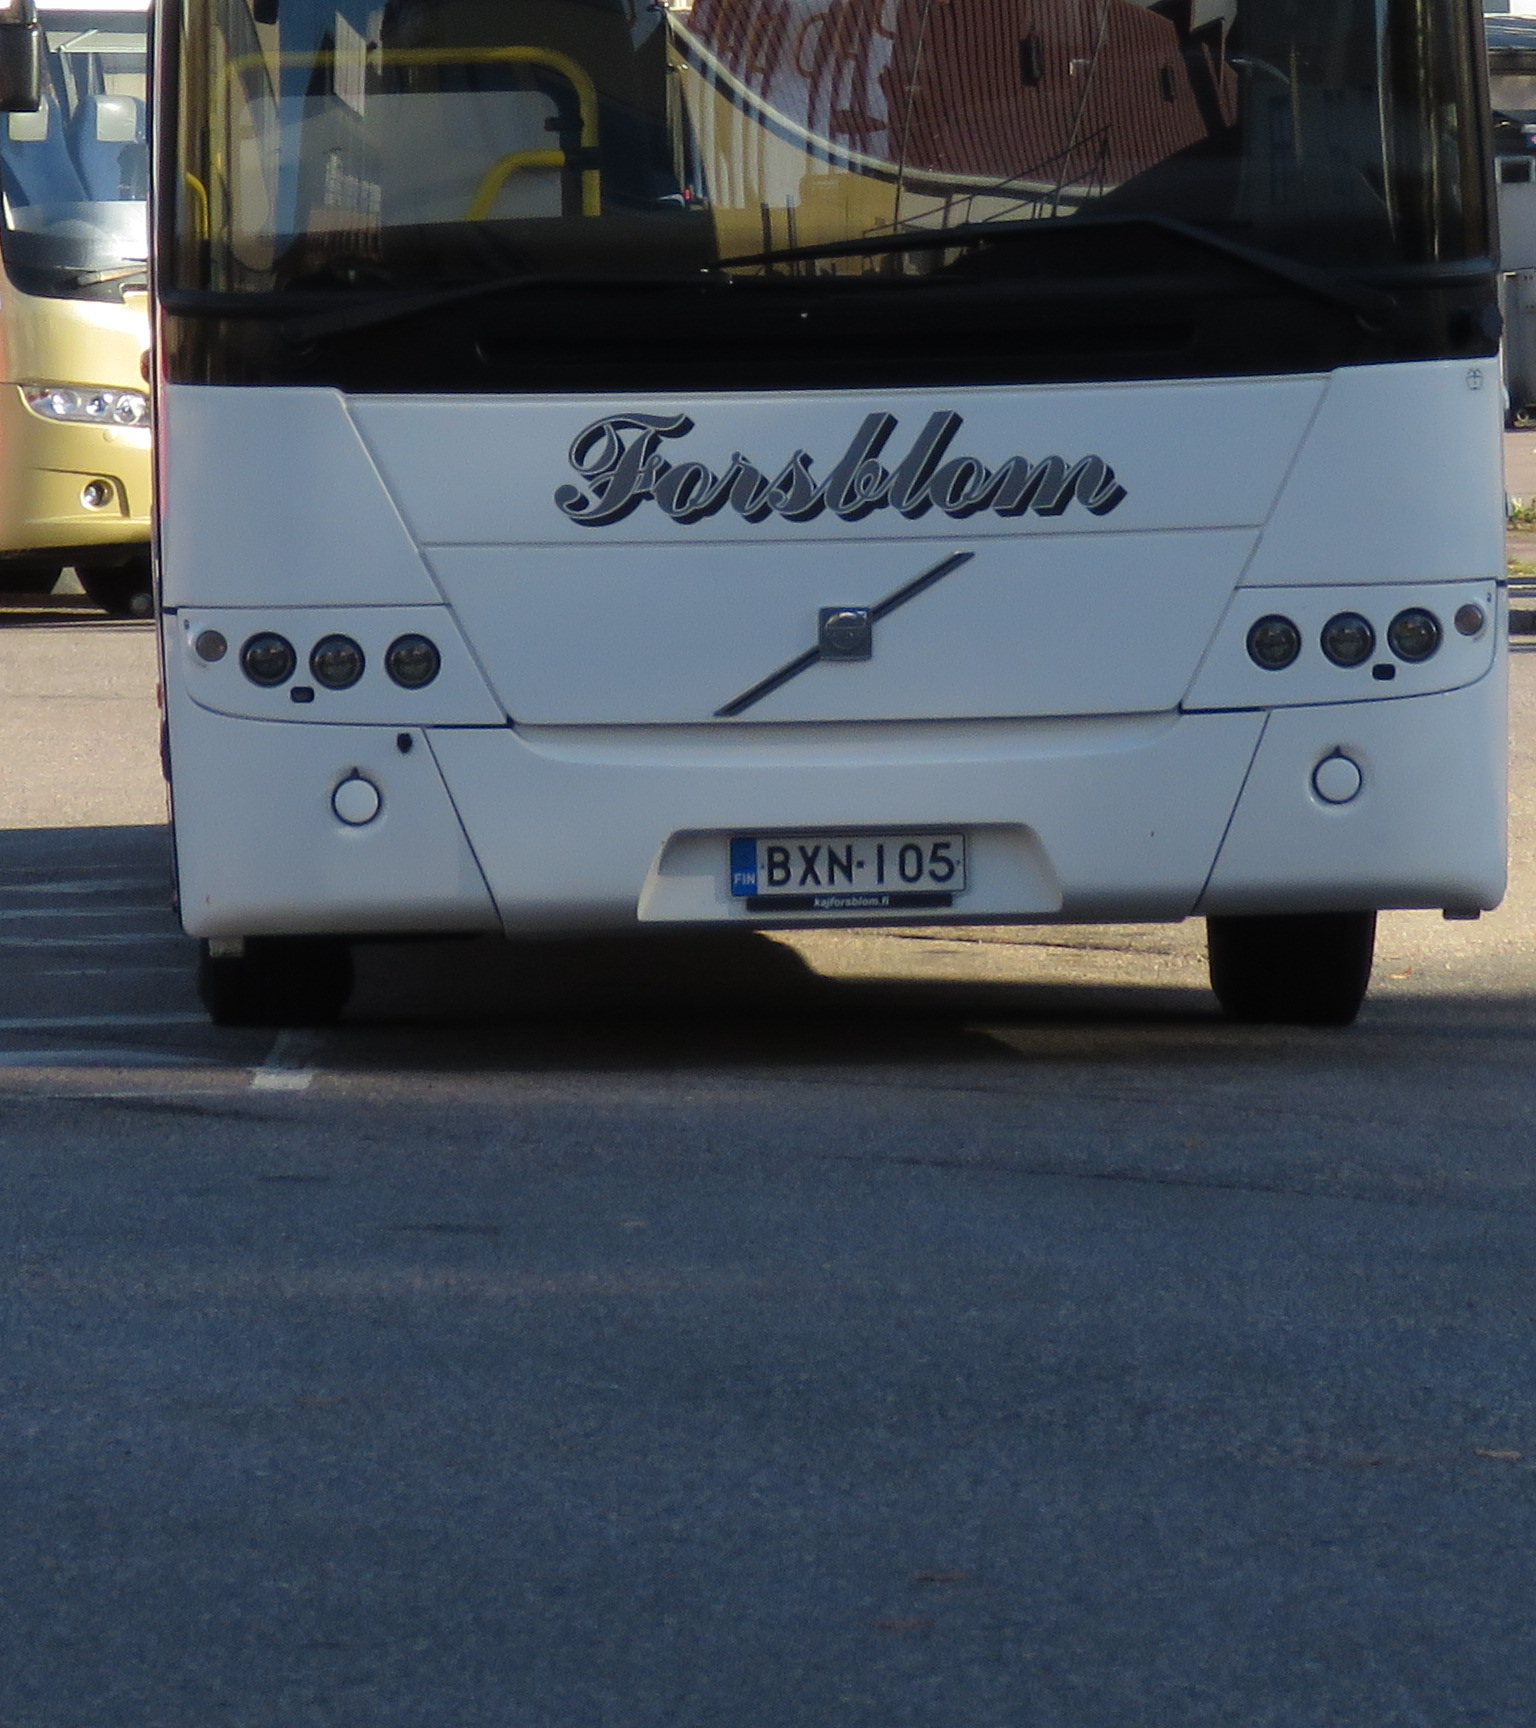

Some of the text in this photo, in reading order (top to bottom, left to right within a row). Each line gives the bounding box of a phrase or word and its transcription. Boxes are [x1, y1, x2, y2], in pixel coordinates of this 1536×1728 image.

[554, 411, 1128, 528] Forsblom
[733, 842, 955, 886] FIN BXN-105
[814, 894, 890, 909] kajforsblom.fi
